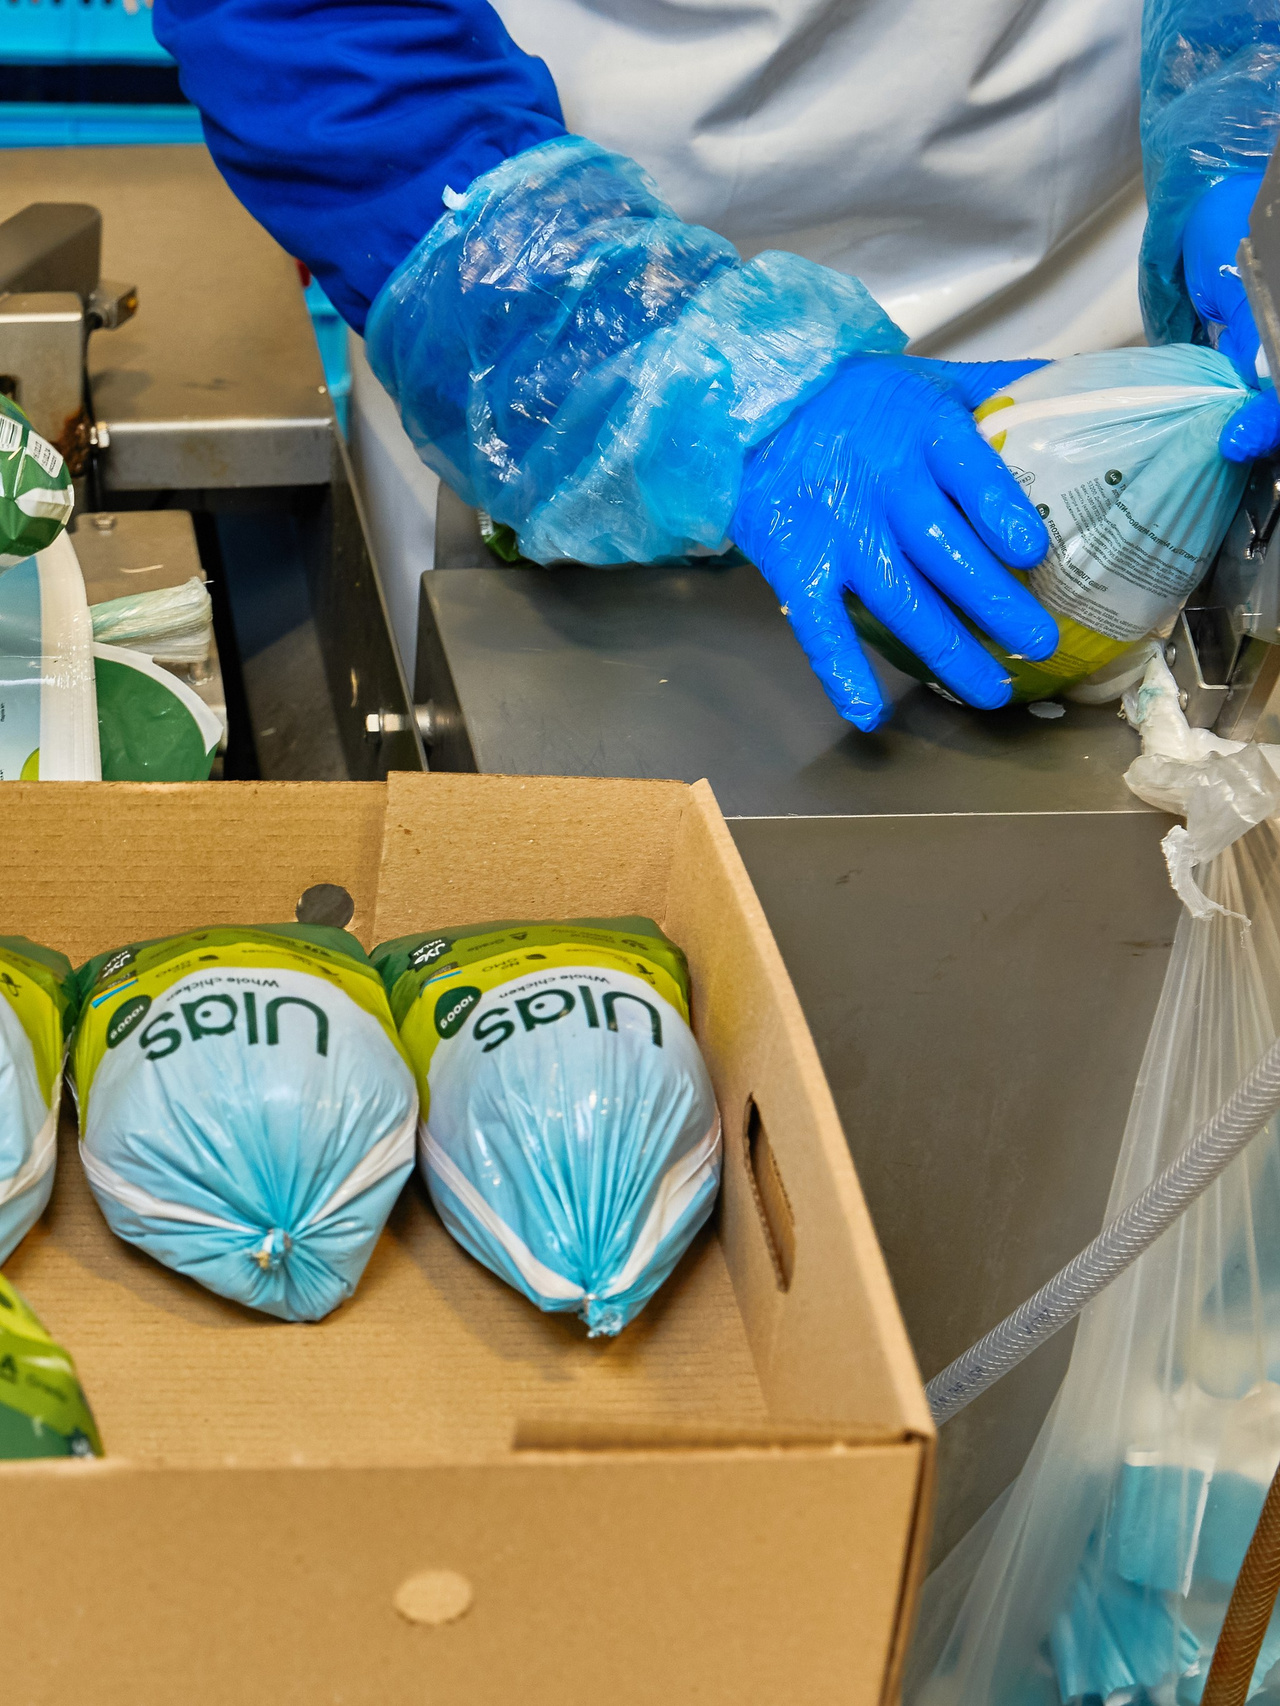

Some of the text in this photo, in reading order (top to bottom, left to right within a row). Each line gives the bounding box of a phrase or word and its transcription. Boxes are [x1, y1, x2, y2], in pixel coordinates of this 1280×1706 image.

[412, 938, 442, 956] HALAL
[502, 960, 521, 971] No
[226, 977, 280, 989] Whole
[499, 973, 611, 1000] Whole chicken
[139, 991, 329, 1062] Ulas
[472, 985, 663, 1053] Ulas
